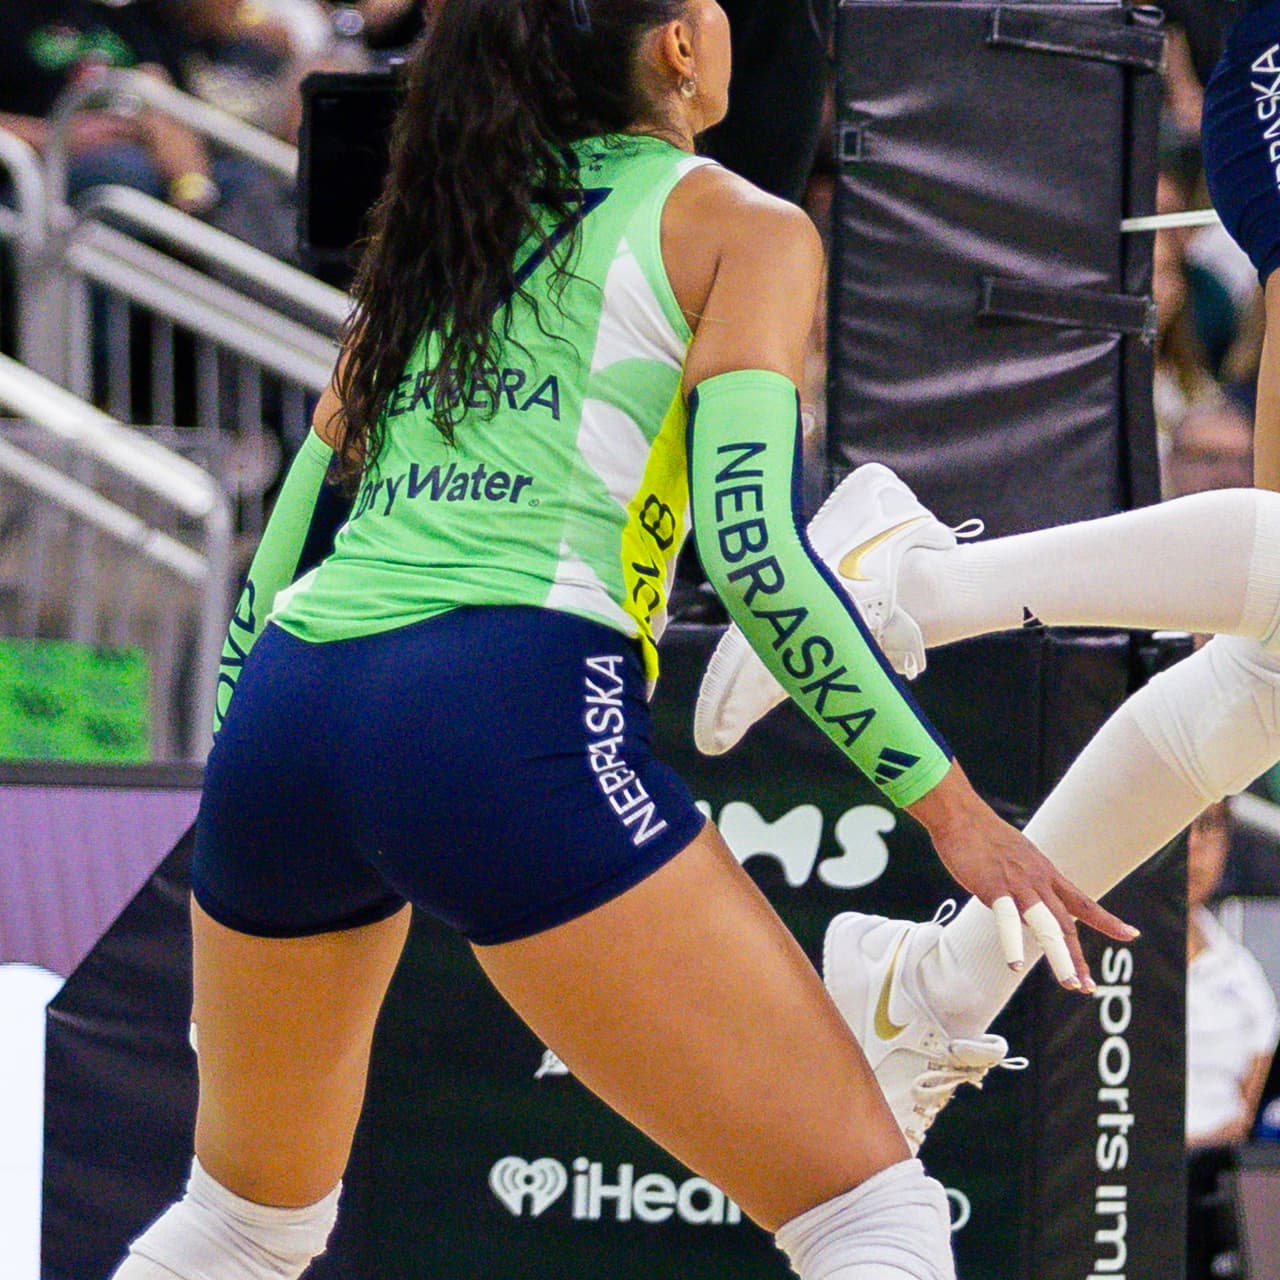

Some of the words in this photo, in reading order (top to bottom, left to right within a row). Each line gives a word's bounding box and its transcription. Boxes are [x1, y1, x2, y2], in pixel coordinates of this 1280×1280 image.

[714, 441, 878, 749] NEBRASKA
[585, 654, 669, 848] NEBRASKA
[1094, 946, 1135, 1171] sports
